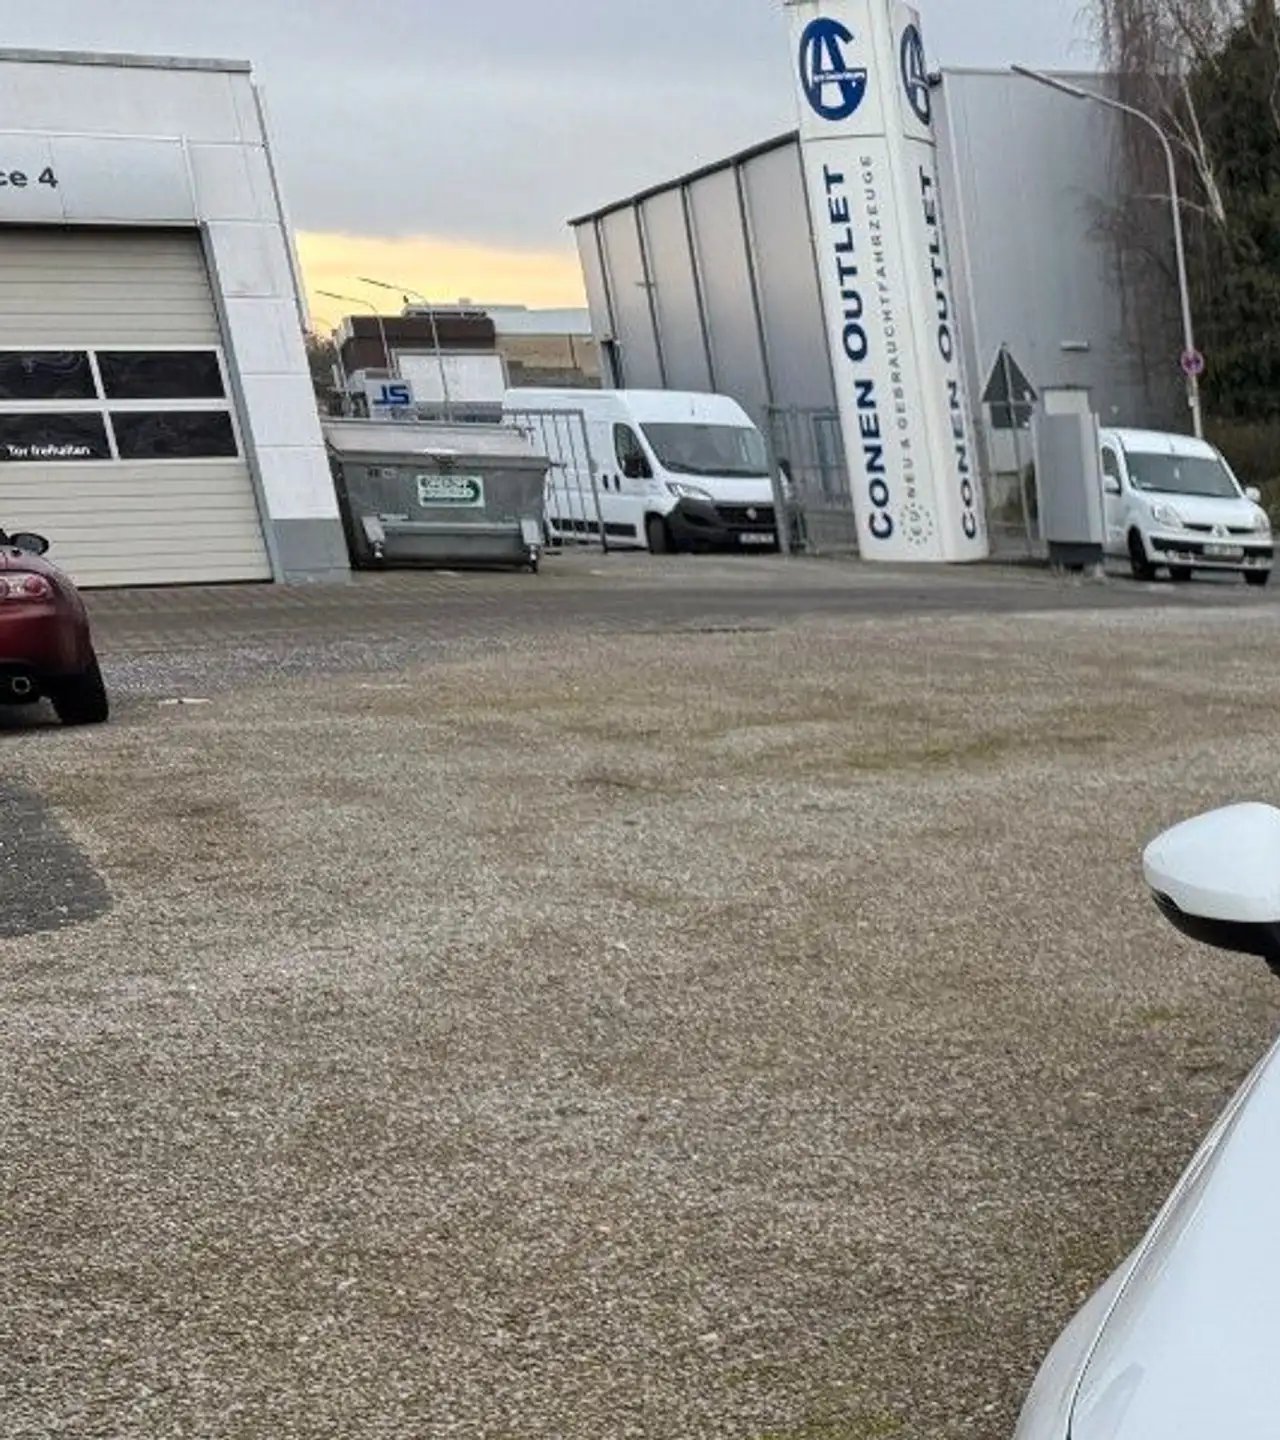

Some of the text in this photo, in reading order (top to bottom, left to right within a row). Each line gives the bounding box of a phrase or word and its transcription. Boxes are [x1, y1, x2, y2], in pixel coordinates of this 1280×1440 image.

[38, 166, 59, 189] 4
[859, 155, 908, 431] GEBRAUCHTFAHRZEUGE
[823, 163, 893, 540] CONEN OUTLET
[902, 457, 917, 499] NEU
[919, 164, 977, 540] CONEN OUTLET
